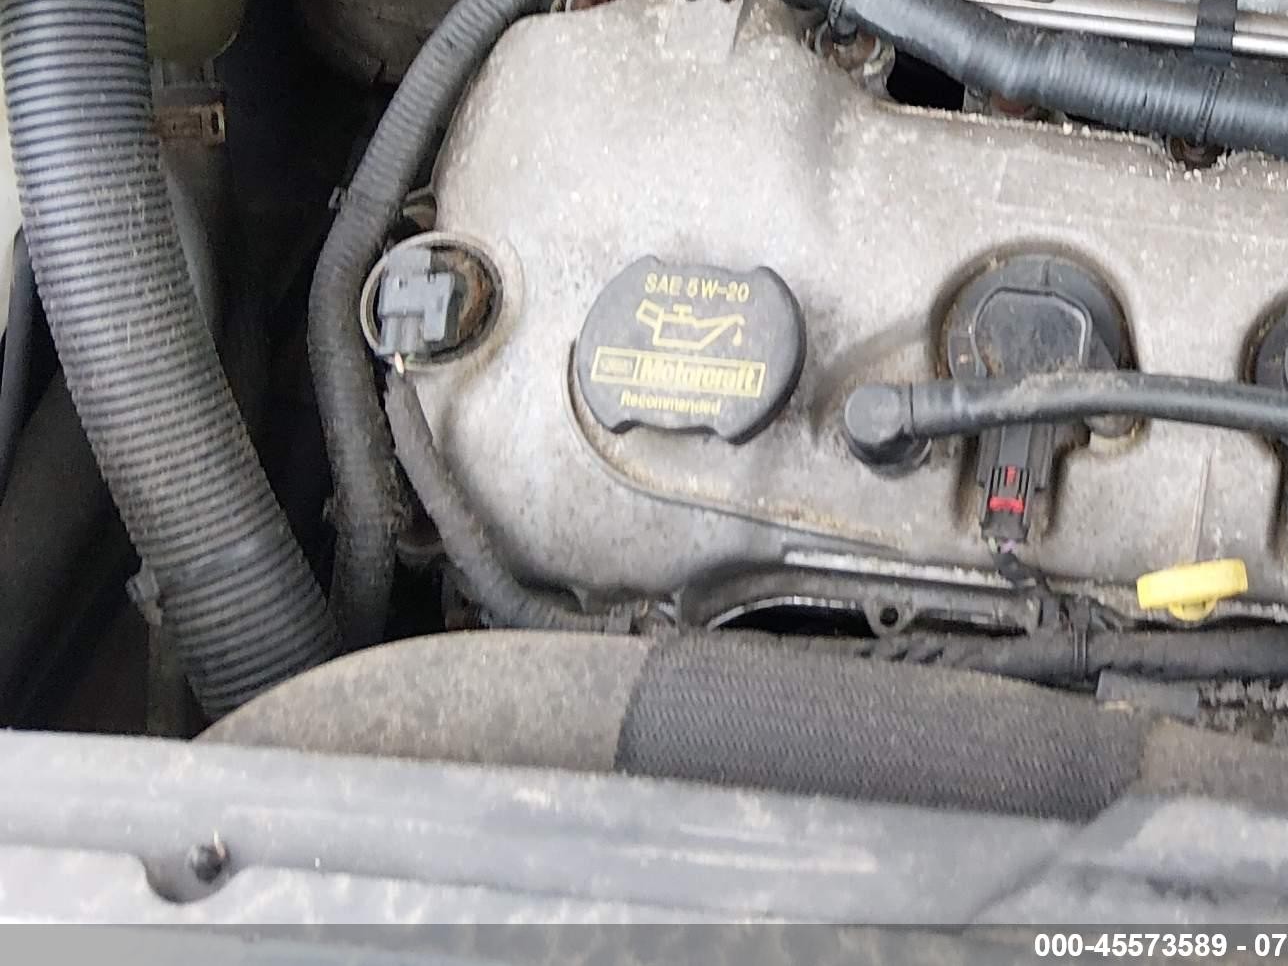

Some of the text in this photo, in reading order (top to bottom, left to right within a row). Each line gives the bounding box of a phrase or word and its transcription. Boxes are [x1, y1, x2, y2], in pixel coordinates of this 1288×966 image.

[645, 272, 750, 303] SAE 5W-20
[640, 357, 755, 393] Motorcraft
[620, 389, 721, 415] Recommended
